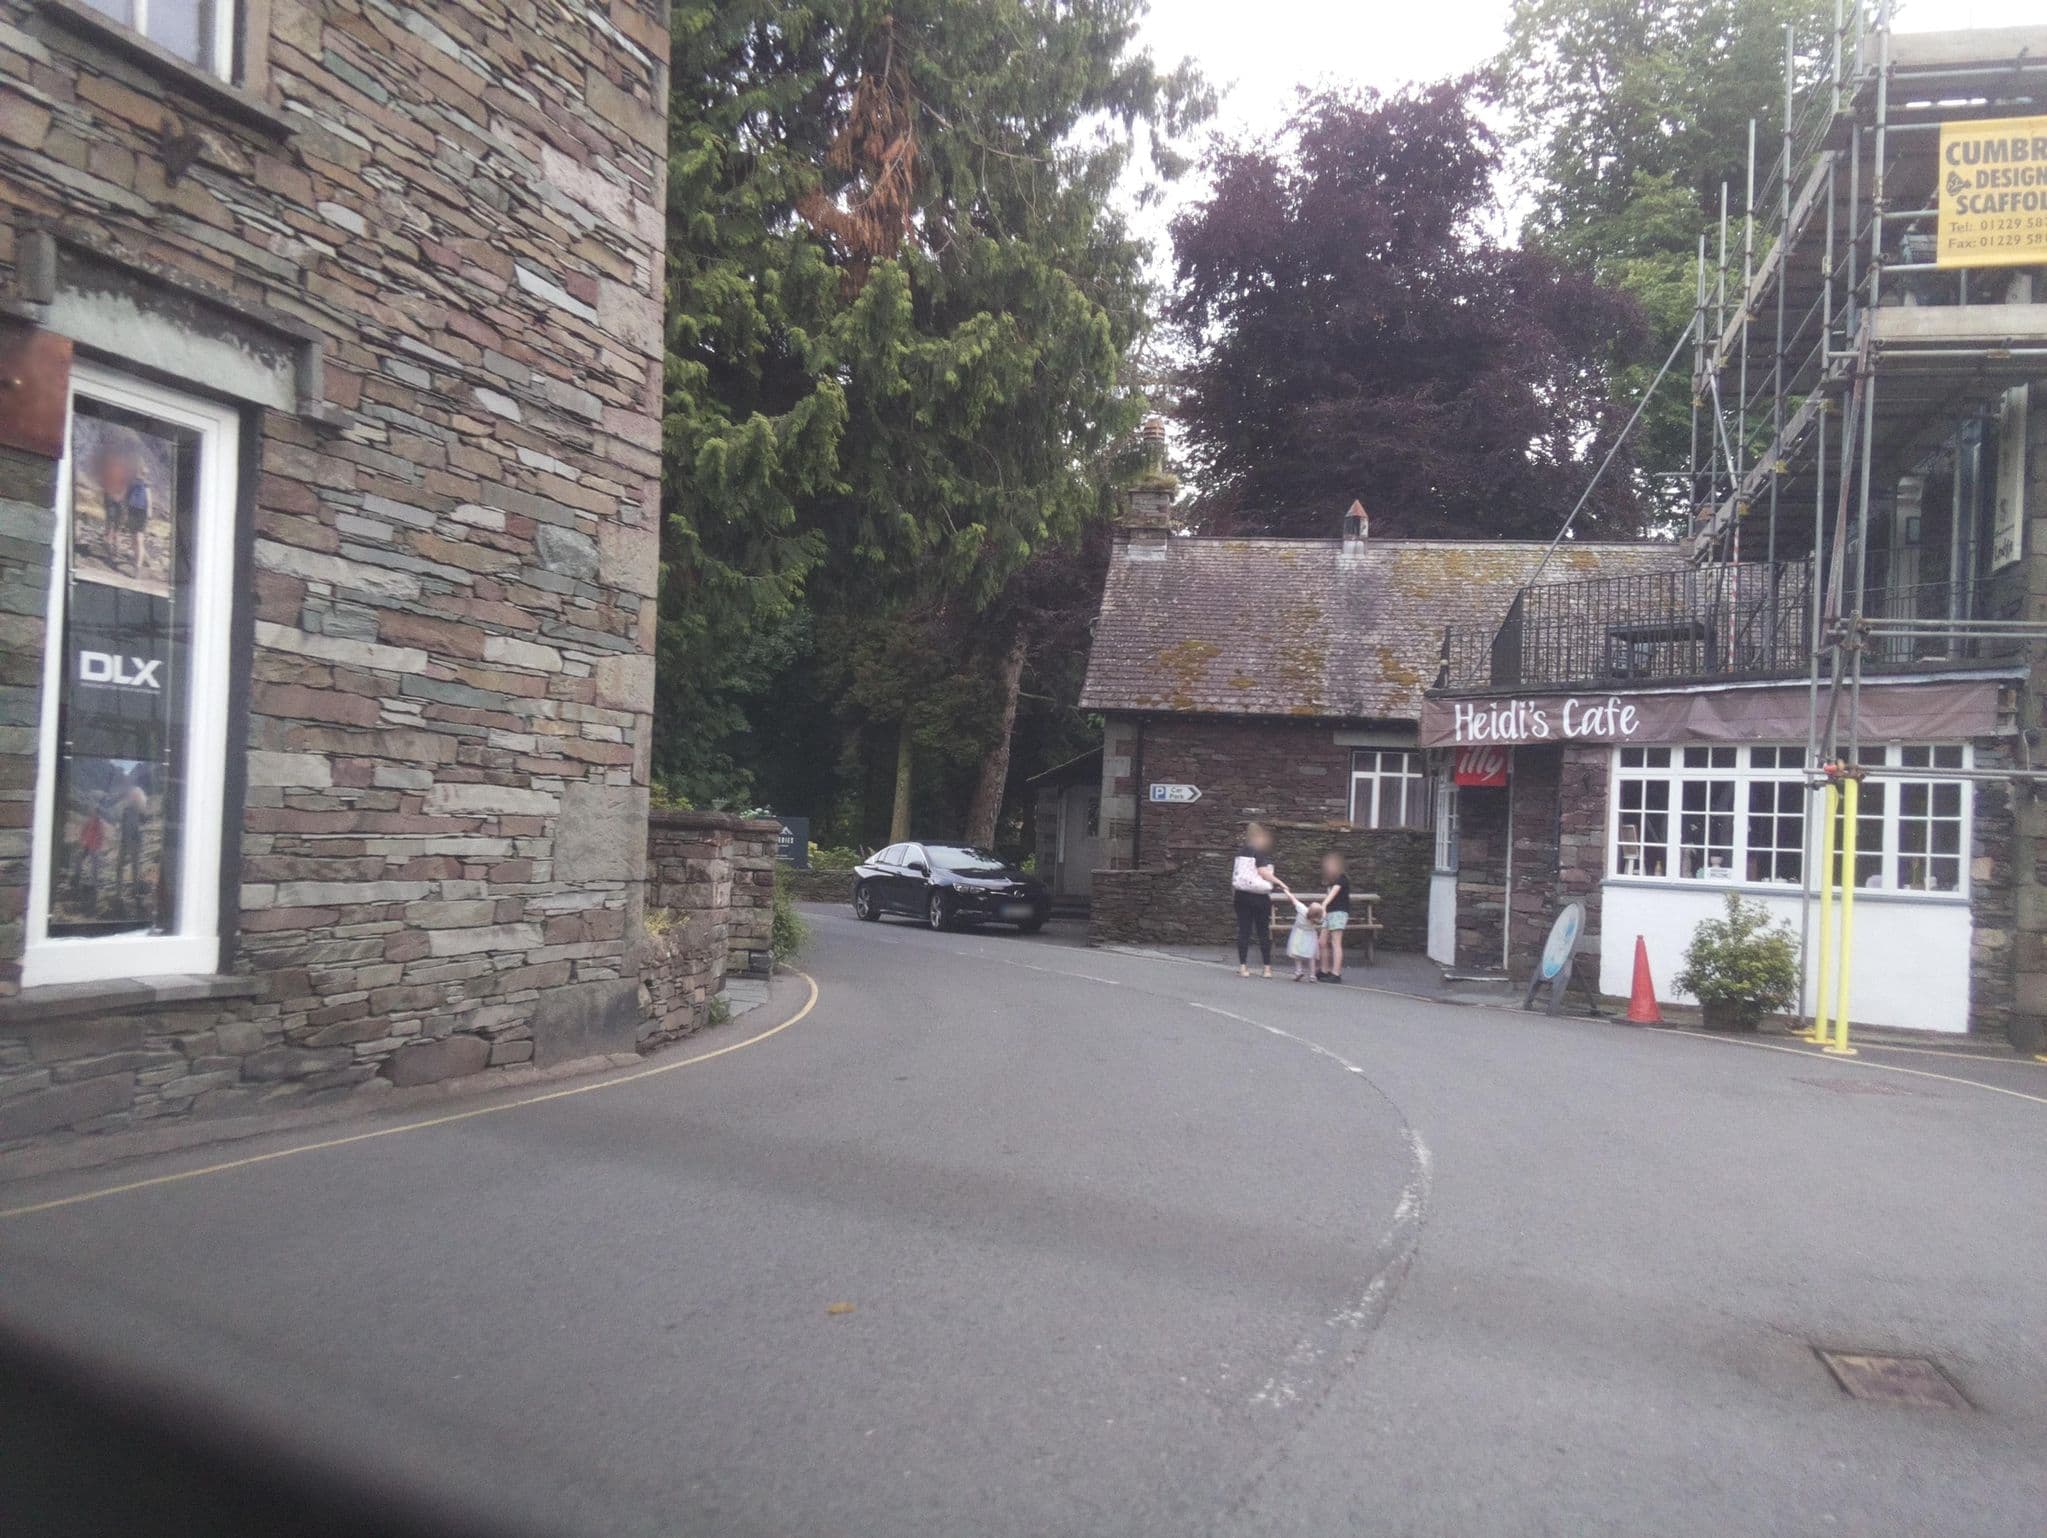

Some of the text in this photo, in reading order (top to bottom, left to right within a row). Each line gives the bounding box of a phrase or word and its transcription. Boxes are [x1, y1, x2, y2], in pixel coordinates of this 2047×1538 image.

[1950, 216, 2047, 232] Tel: 01229 58
[1948, 232, 2047, 248] Fax: 01229 58
[80, 650, 162, 688] DLX
[1455, 696, 1640, 742] Heidi's Cafe
[1155, 787, 1164, 799] P
